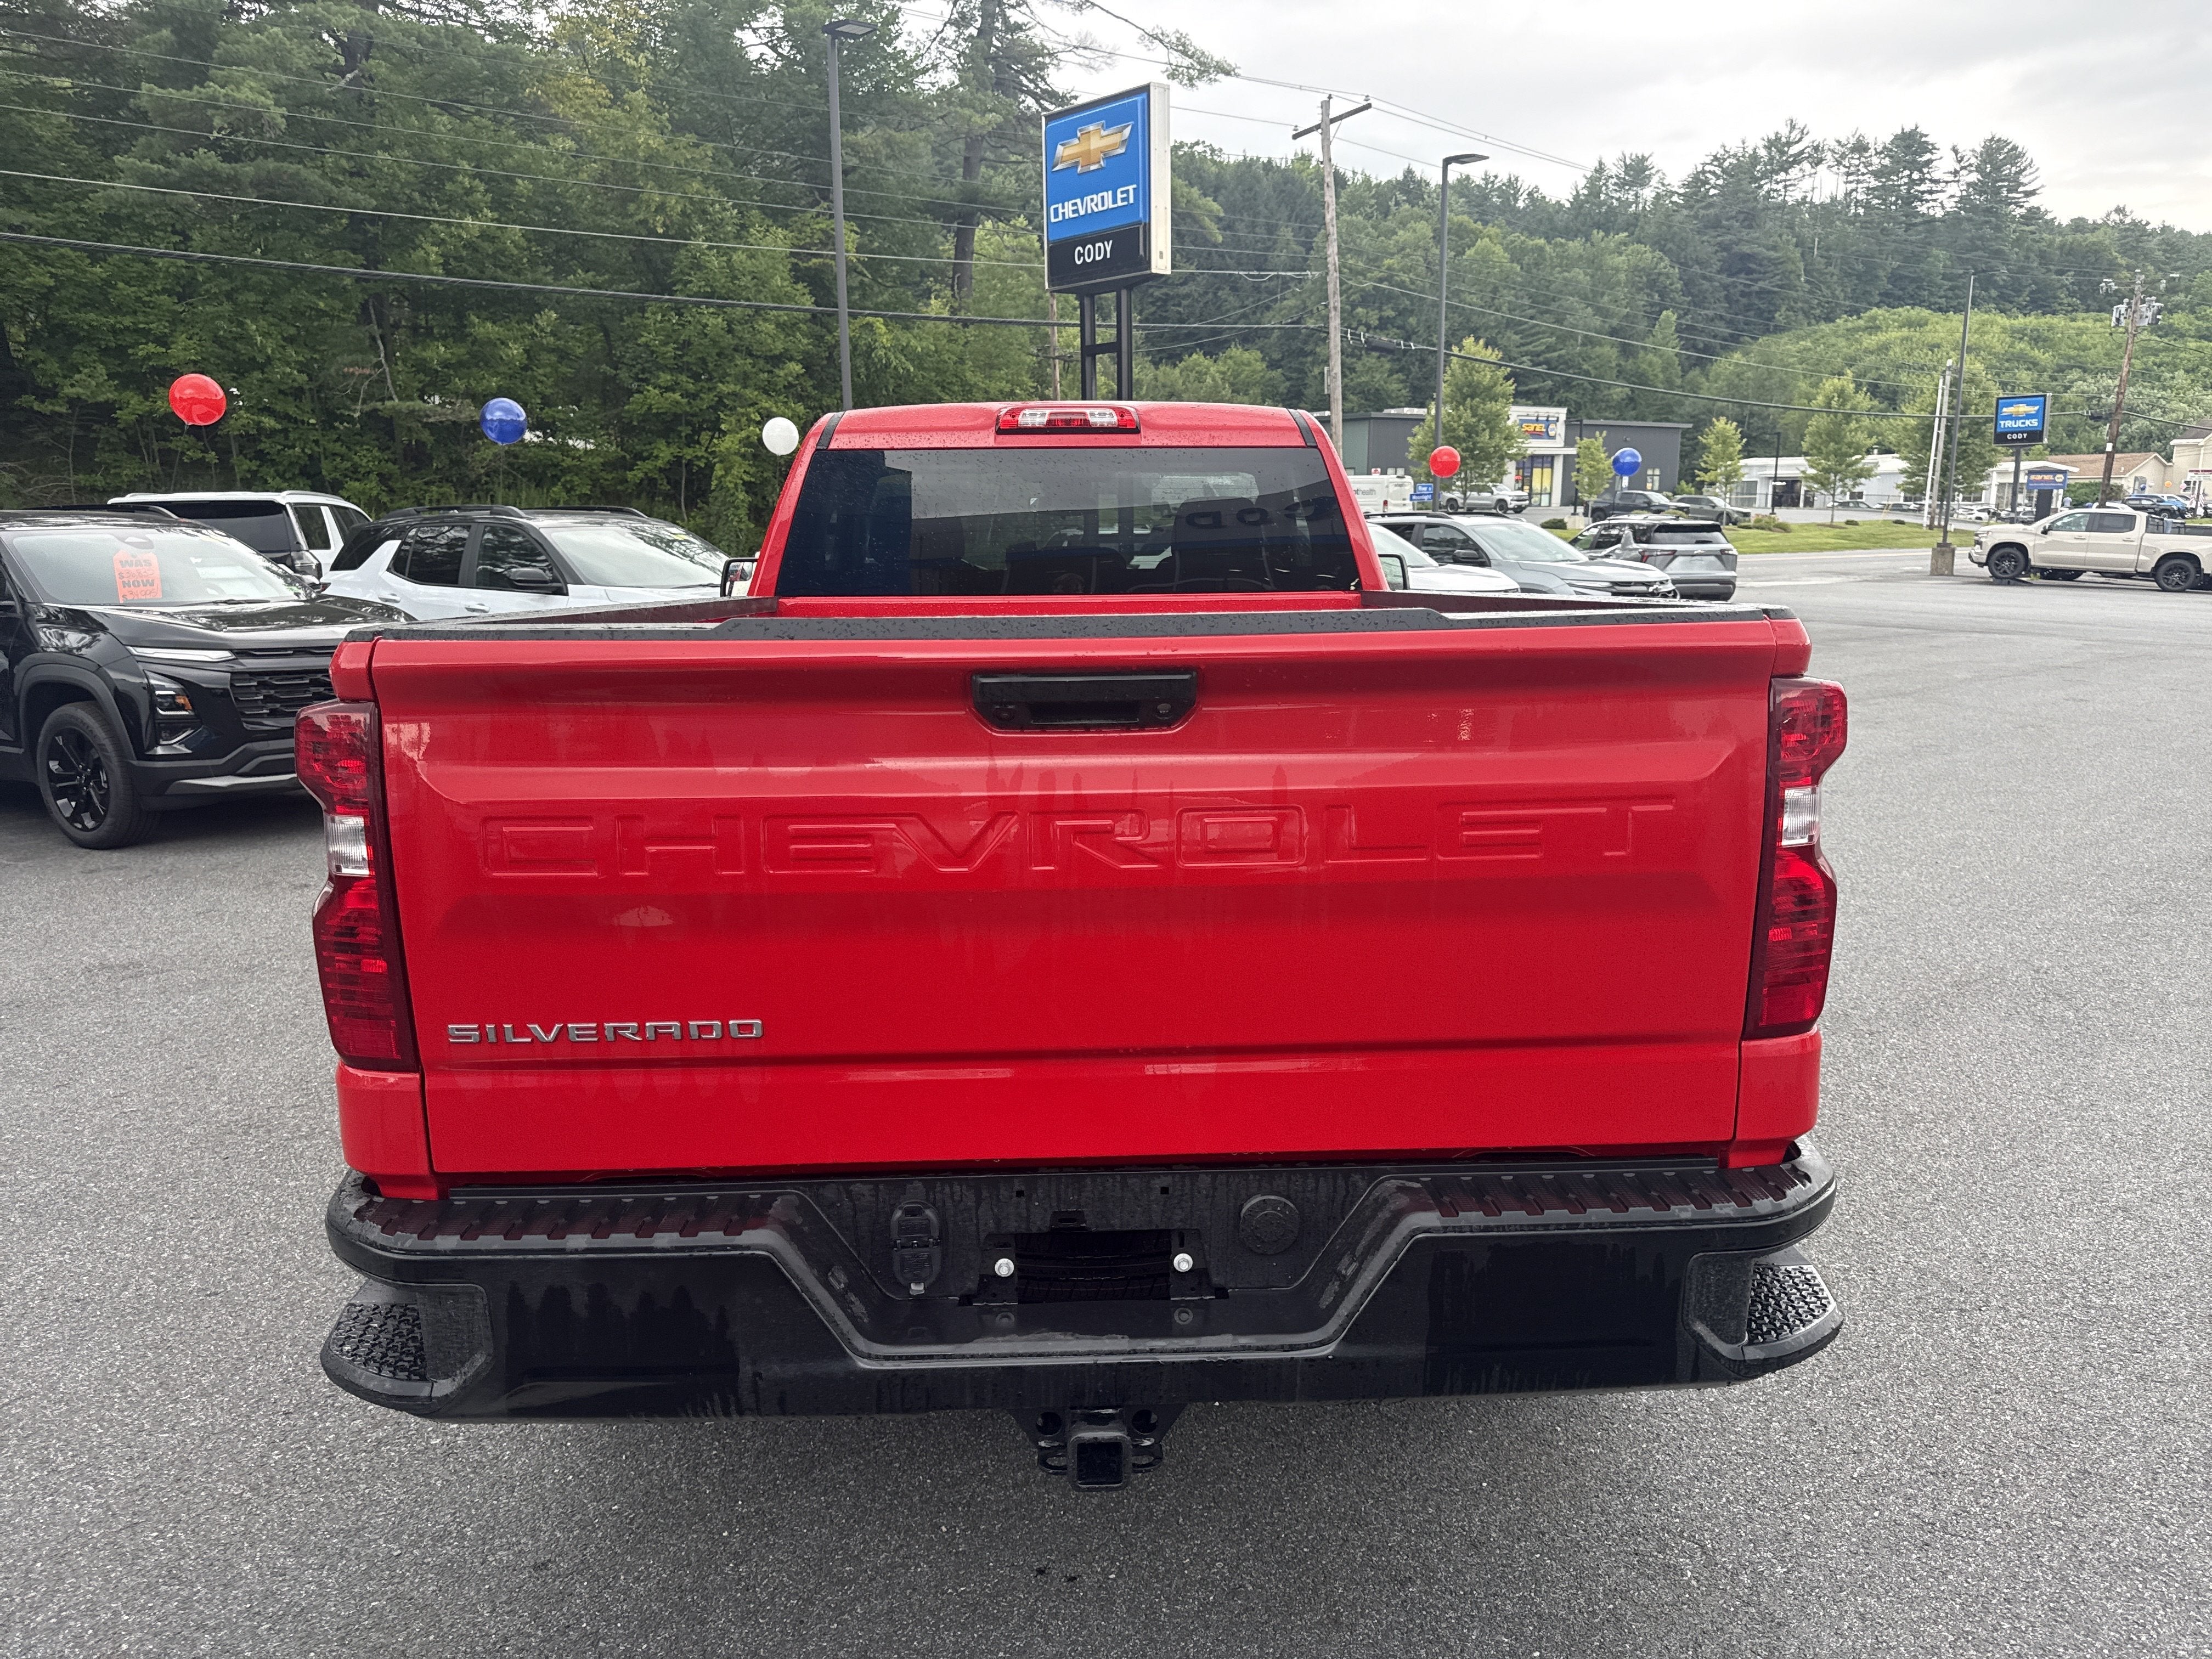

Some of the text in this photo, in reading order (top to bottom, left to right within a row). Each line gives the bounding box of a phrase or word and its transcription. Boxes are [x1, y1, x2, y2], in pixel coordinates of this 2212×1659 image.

[1050, 184, 1137, 223] CHEVROLET
[1074, 240, 1113, 265] CODY
[1999, 419, 2039, 428] TRUCKS
[119, 559, 152, 568] WAS
[122, 579, 155, 588] NOW
[481, 798, 1677, 878] CHEVROLET
[447, 1018, 764, 1043] SILVERADO
